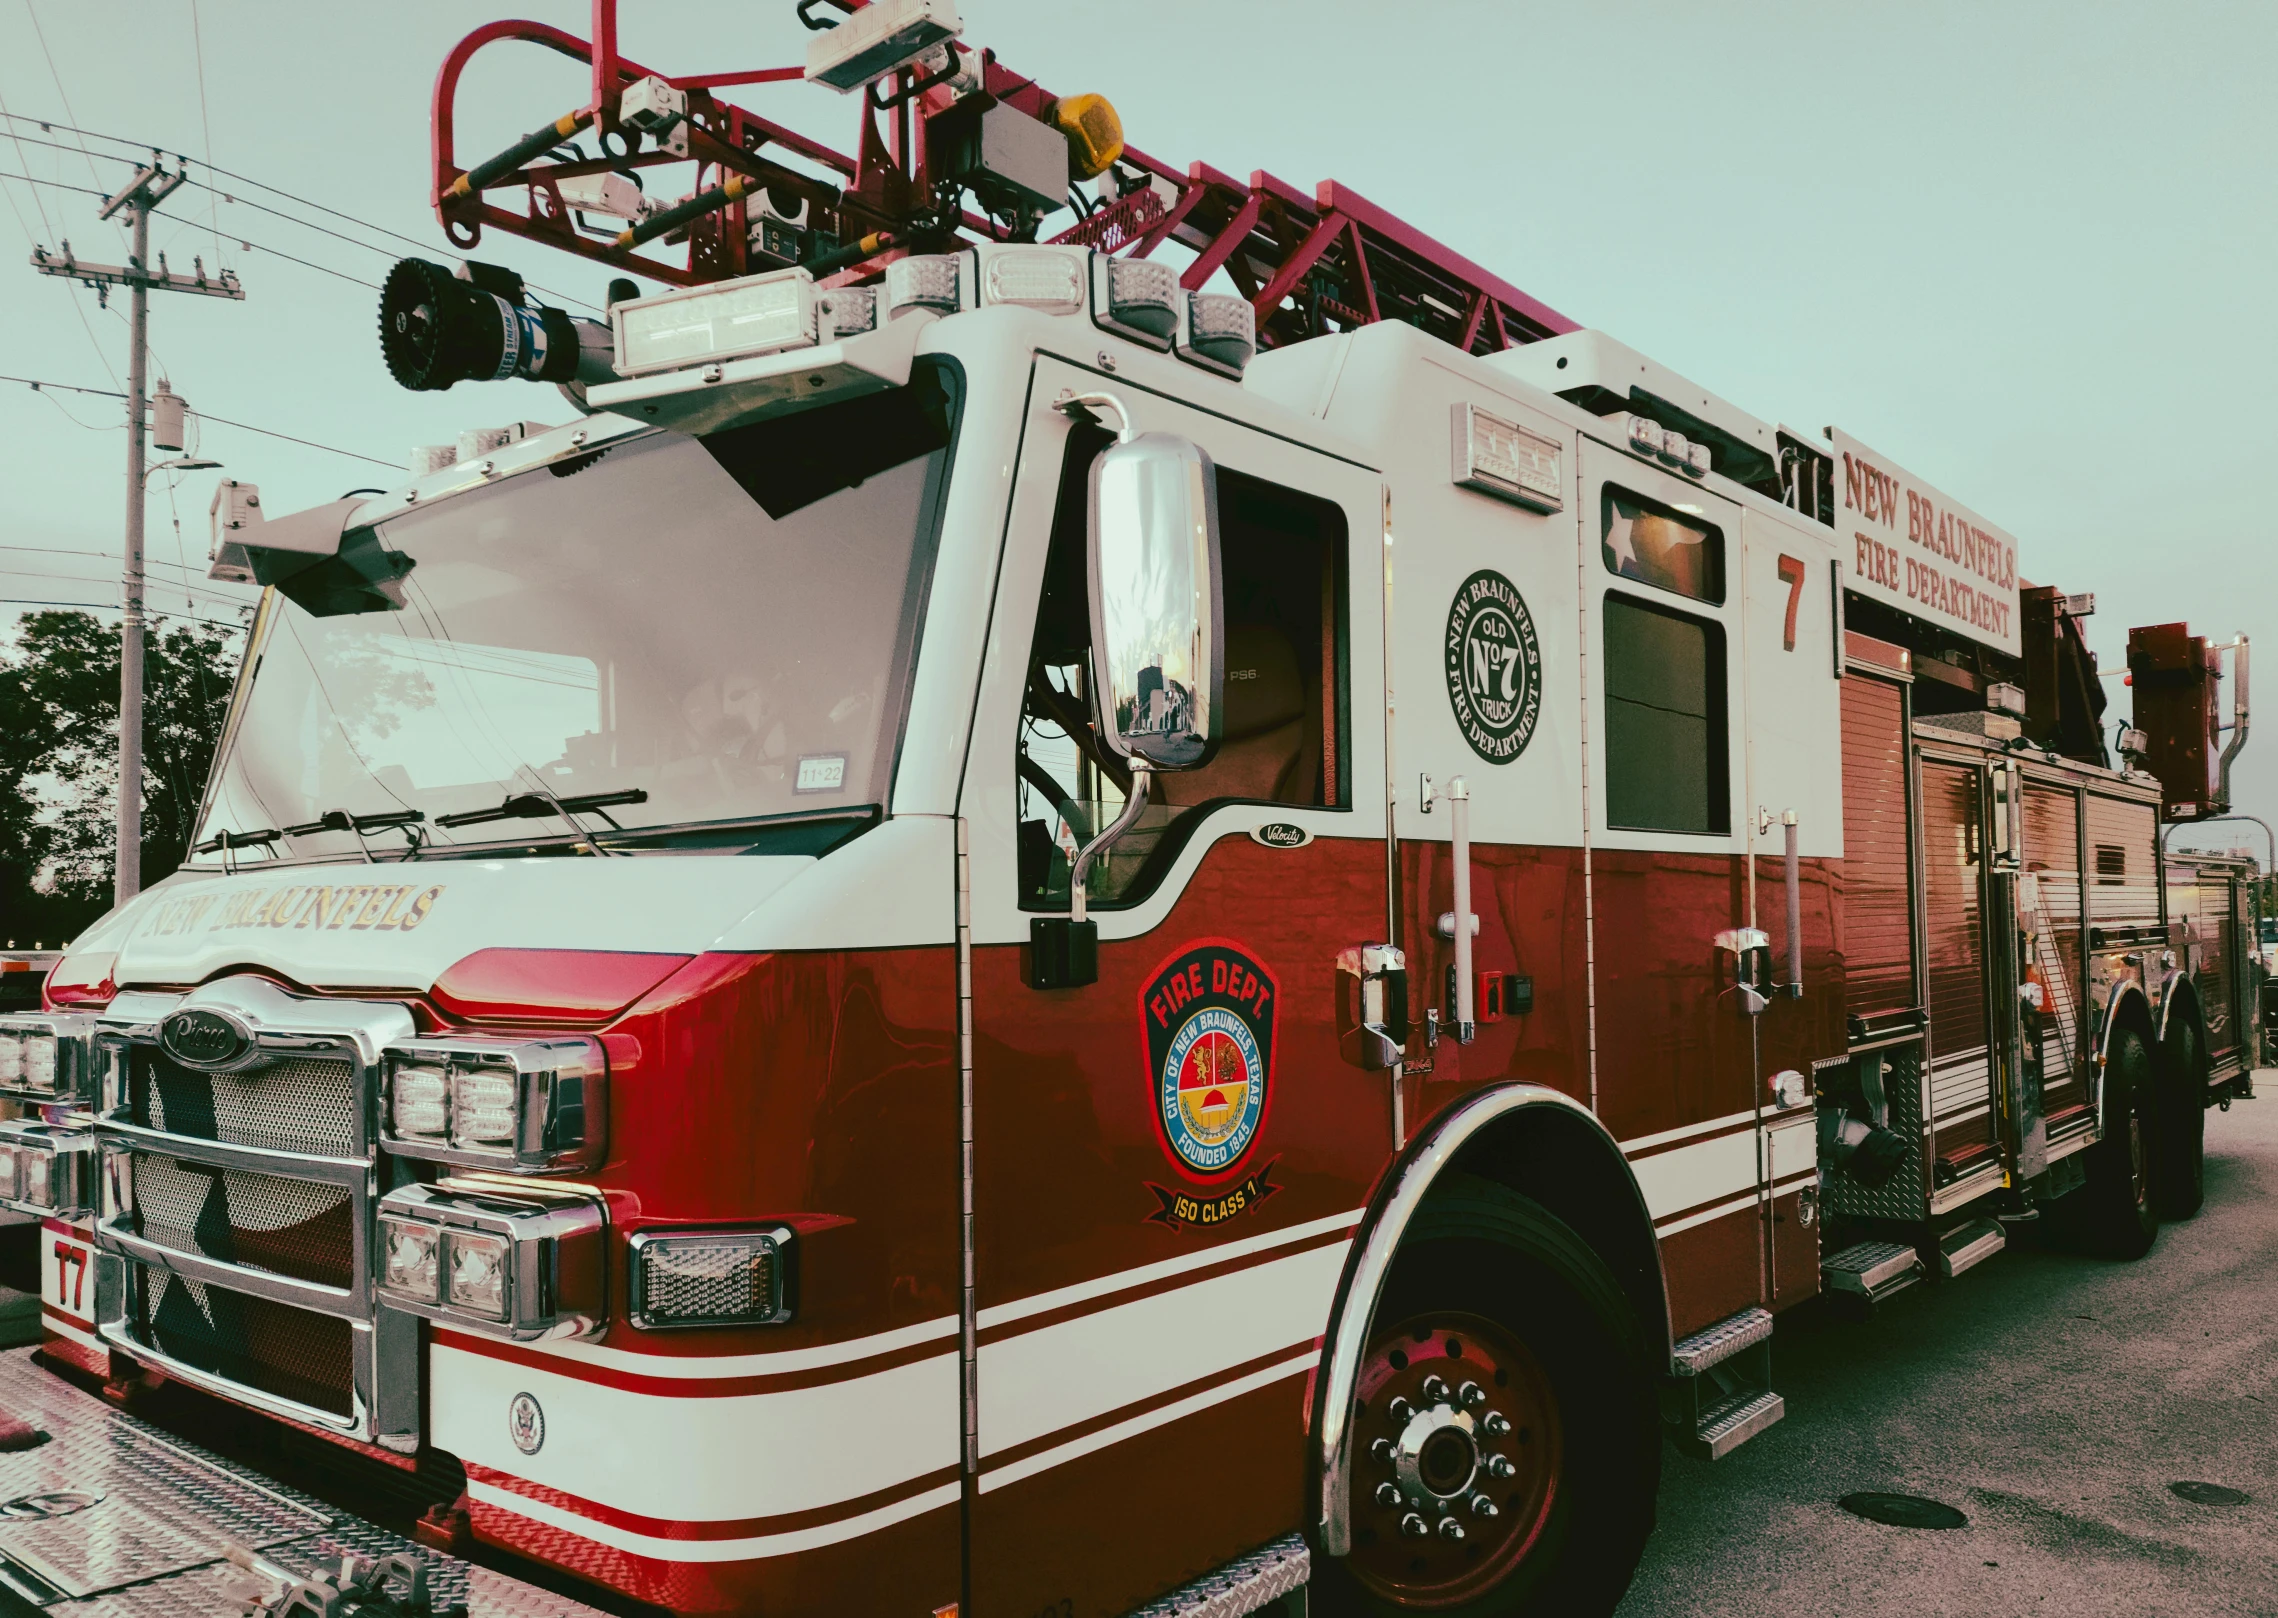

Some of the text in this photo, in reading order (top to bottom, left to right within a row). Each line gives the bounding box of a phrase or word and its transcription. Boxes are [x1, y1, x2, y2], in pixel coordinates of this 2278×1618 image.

[1843, 451, 2014, 592] NEW BRAUNFELS
[1778, 553, 1805, 652] 7
[1855, 532, 2010, 638] FIRE DEPARTMENT
[1449, 579, 1538, 665] NEW BRAUNFELS
[1483, 618, 1507, 638] OLD
[1450, 668, 1539, 757] FIRE DEPARTMENT
[1481, 698, 1512, 720] TRUCK
[824, 766, 842, 781] 22
[1267, 825, 1301, 845] Velocity
[141, 884, 446, 938] NEW BRAUNFELS
[1150, 959, 1270, 1029] FIRE DEPT.
[174, 1015, 229, 1049] Pierce
[1166, 1013, 1260, 1120] CITY OF NEW BRAUNFELS, TEXAS
[1178, 1122, 1250, 1165] FOUNDED 1845
[1174, 1180, 1256, 1222] ISO CLASS 1
[54, 1240, 88, 1311] T7
